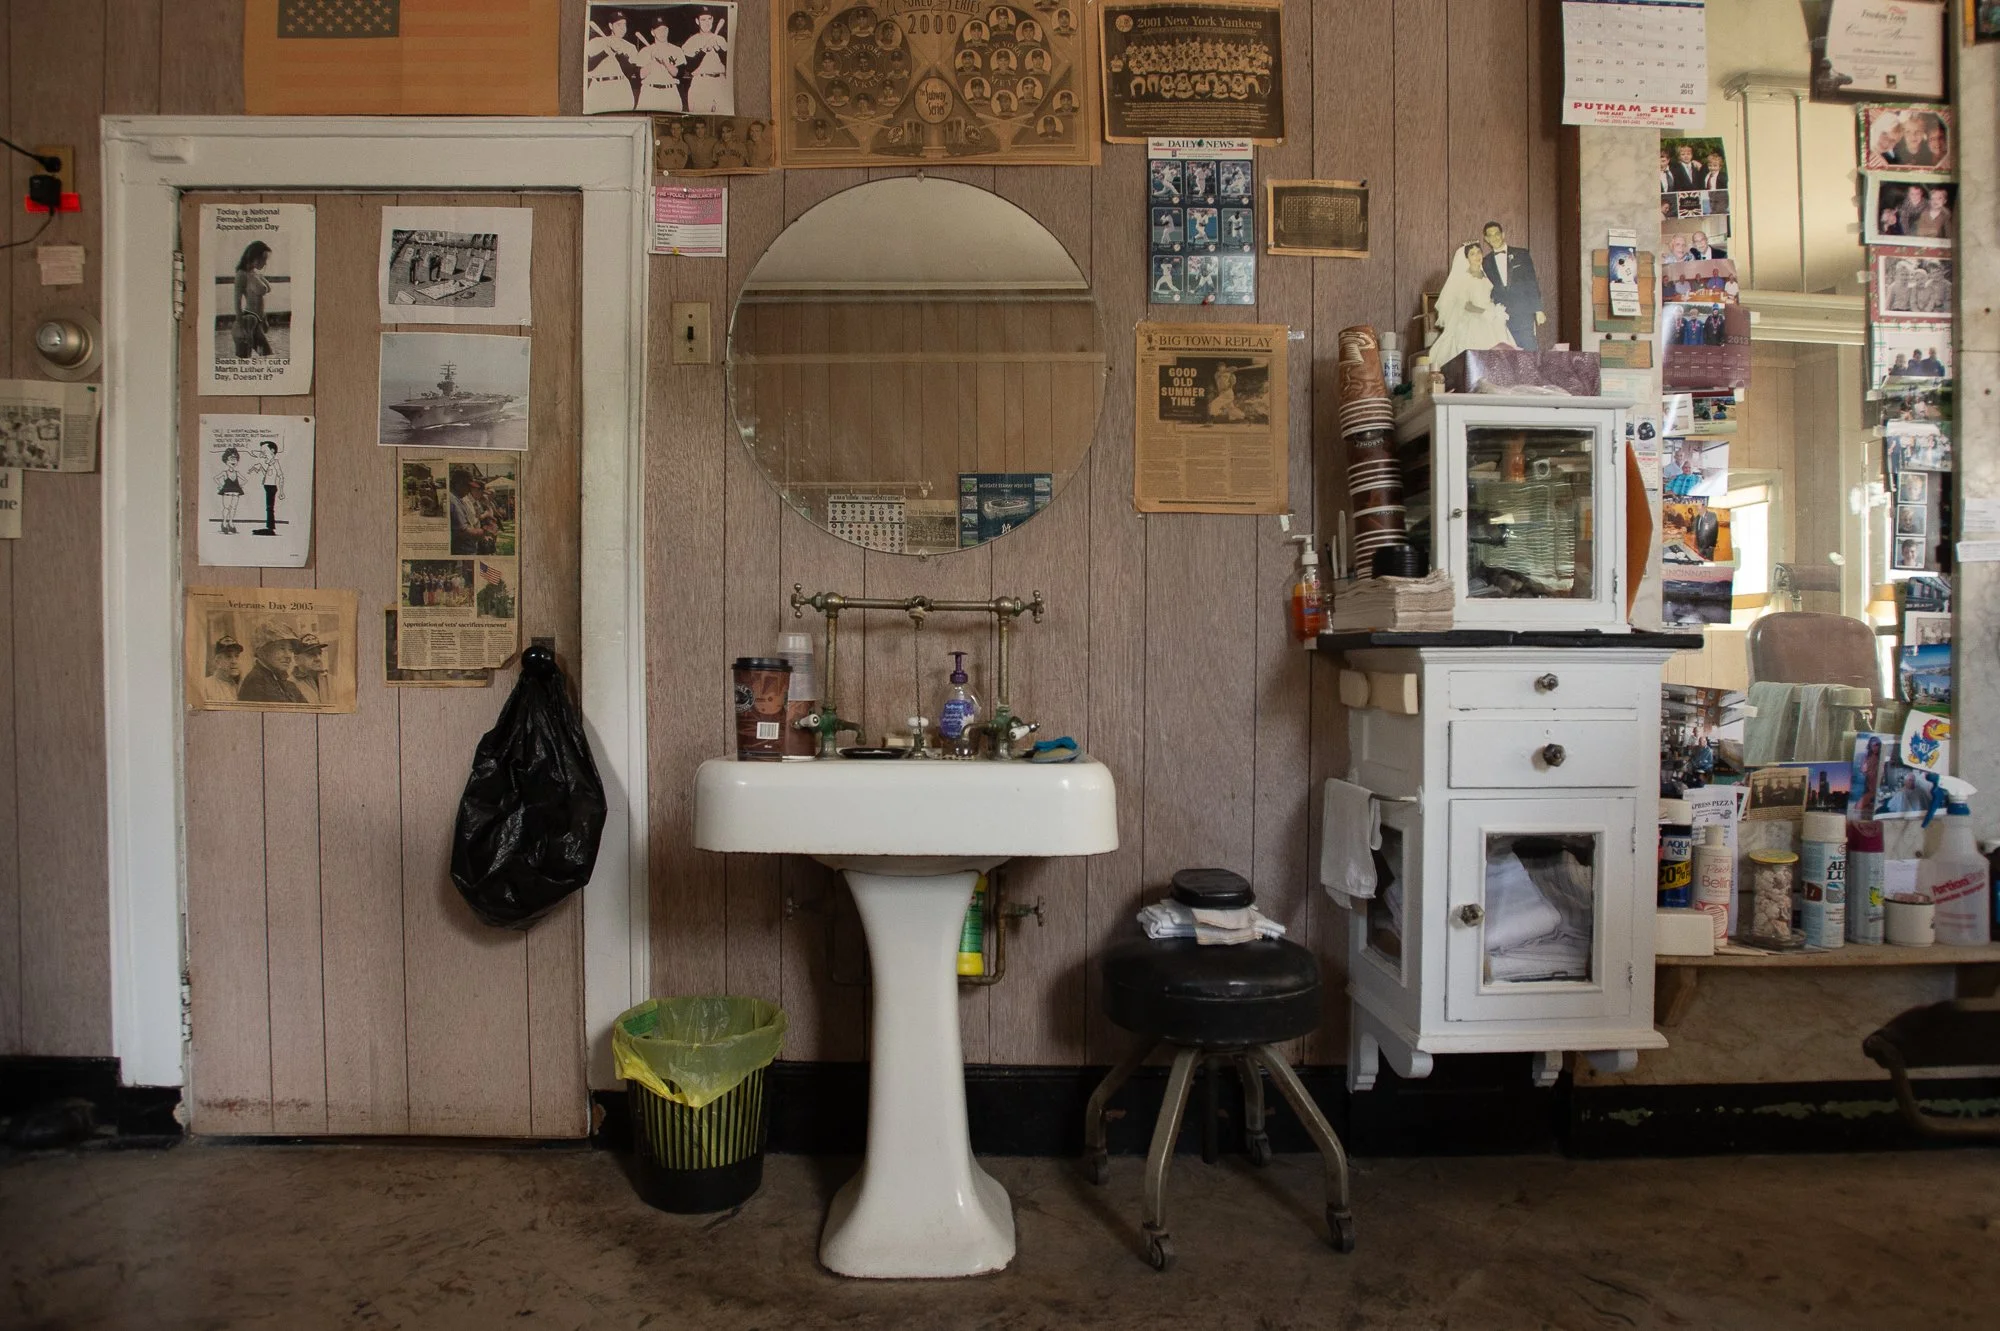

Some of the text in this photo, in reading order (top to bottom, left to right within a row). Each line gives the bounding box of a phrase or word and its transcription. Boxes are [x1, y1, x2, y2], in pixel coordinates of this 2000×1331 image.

[907, 14, 957, 34] 2000
[1137, 15, 1262, 29] 2001 New York Yankees
[925, 83, 947, 105] Subway
[928, 101, 946, 116] Series
[1573, 102, 1697, 115] PUTNAM SHELL
[1168, 140, 1234, 148] DAILY NEWS
[216, 208, 280, 217] Today is National
[216, 223, 280, 232] Appreciation Day
[1159, 335, 1273, 348] BIG TOWN REPLAY
[266, 366, 284, 374] King
[1168, 367, 1197, 377] GOOD
[215, 373, 231, 381] Day,
[1173, 377, 1193, 387] OLD
[1161, 387, 1205, 397] SUMMER
[1171, 397, 1196, 407] TIME
[226, 600, 314, 612] Veterans Day 2005
[1667, 840, 1690, 848] AQUA
